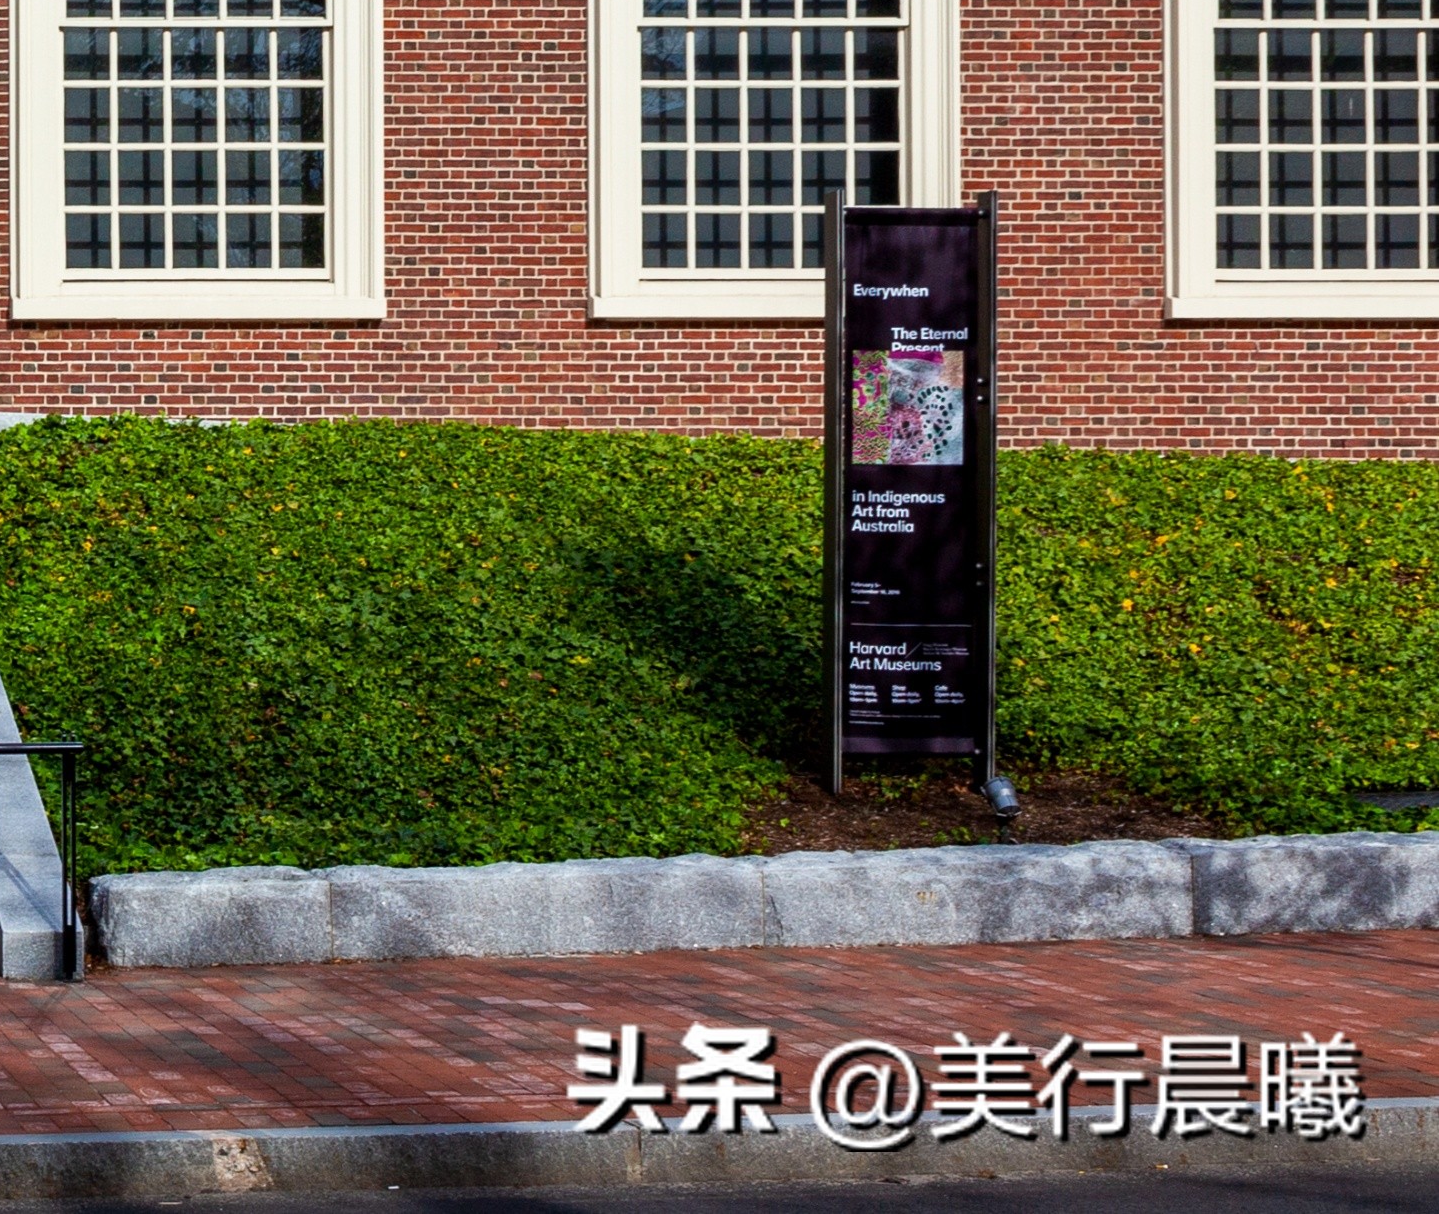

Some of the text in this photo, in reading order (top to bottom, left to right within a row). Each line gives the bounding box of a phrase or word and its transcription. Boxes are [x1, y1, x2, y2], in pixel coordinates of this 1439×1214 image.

[853, 283, 929, 300] Everywhen
[891, 327, 969, 340] The Eternal
[852, 490, 946, 506] in Indigenous
[851, 505, 909, 518] Art from
[851, 519, 915, 533] Australia
[849, 641, 907, 655] Harvard
[849, 656, 942, 672] Art Museums
